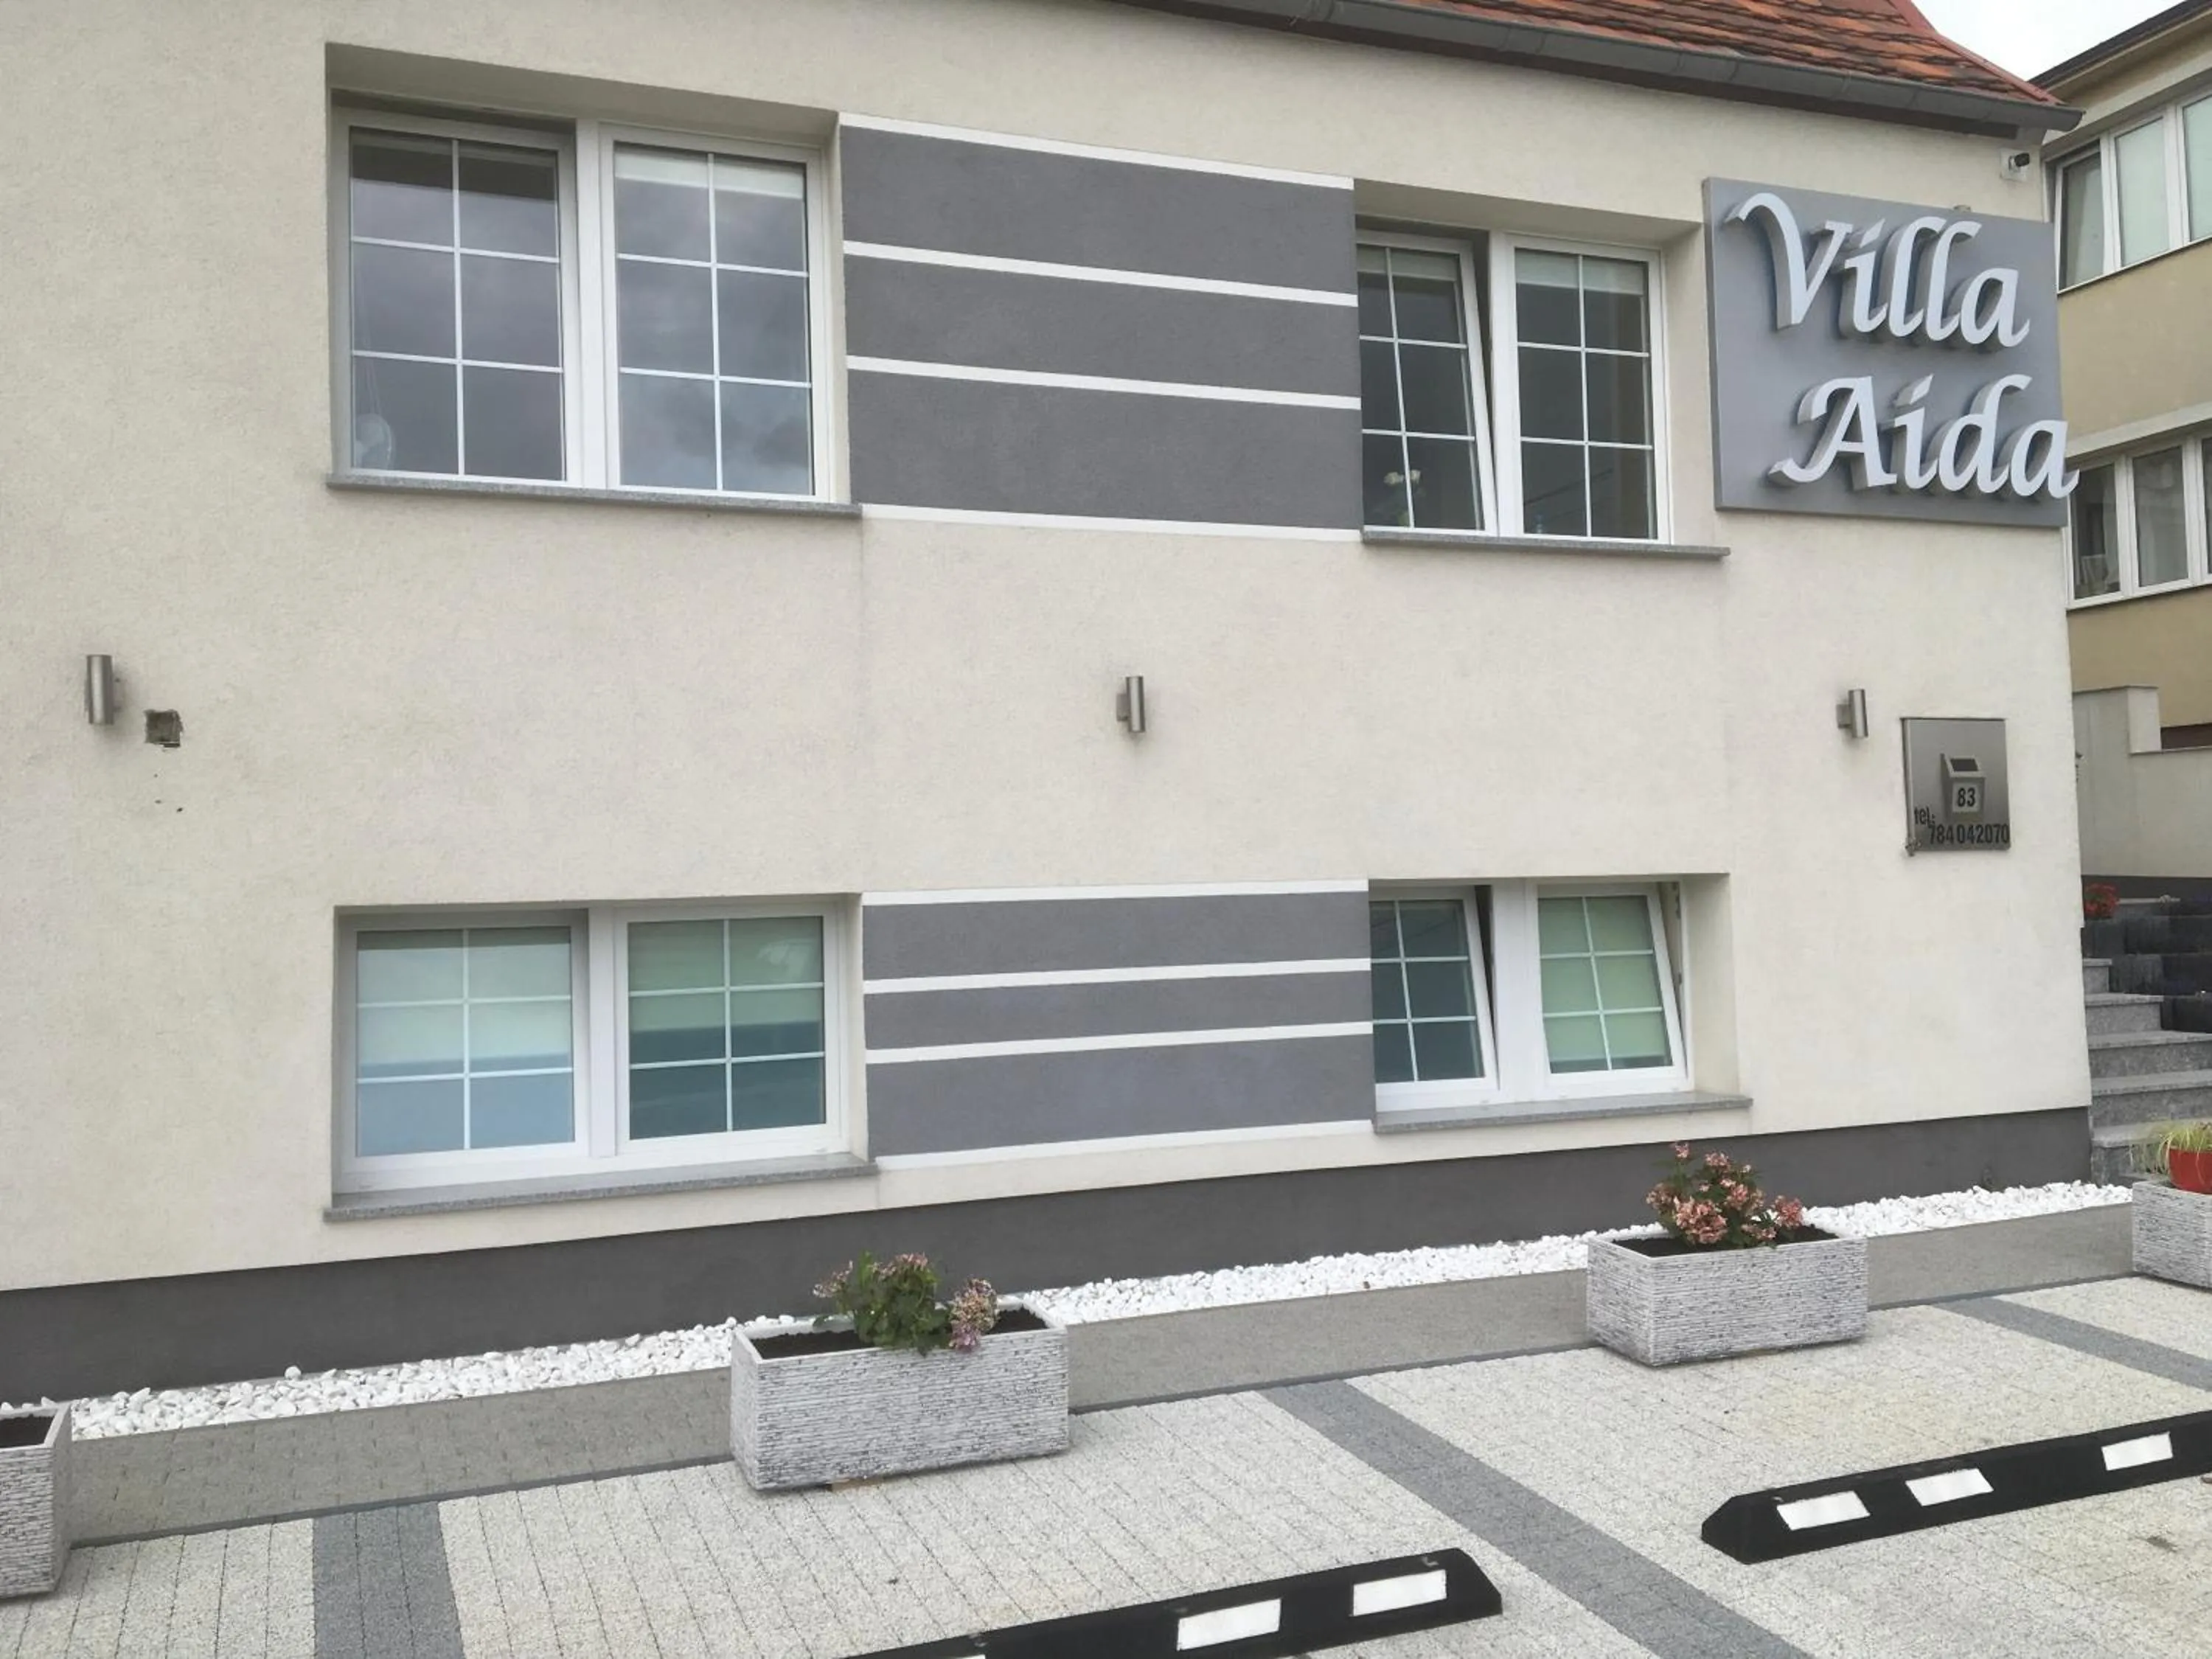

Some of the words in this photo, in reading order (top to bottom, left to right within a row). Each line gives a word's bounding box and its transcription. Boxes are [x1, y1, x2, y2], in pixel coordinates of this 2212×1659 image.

[1730, 192, 2030, 347] Villa
[1769, 374, 2079, 498] Aida
[1958, 787, 1975, 807] 83
